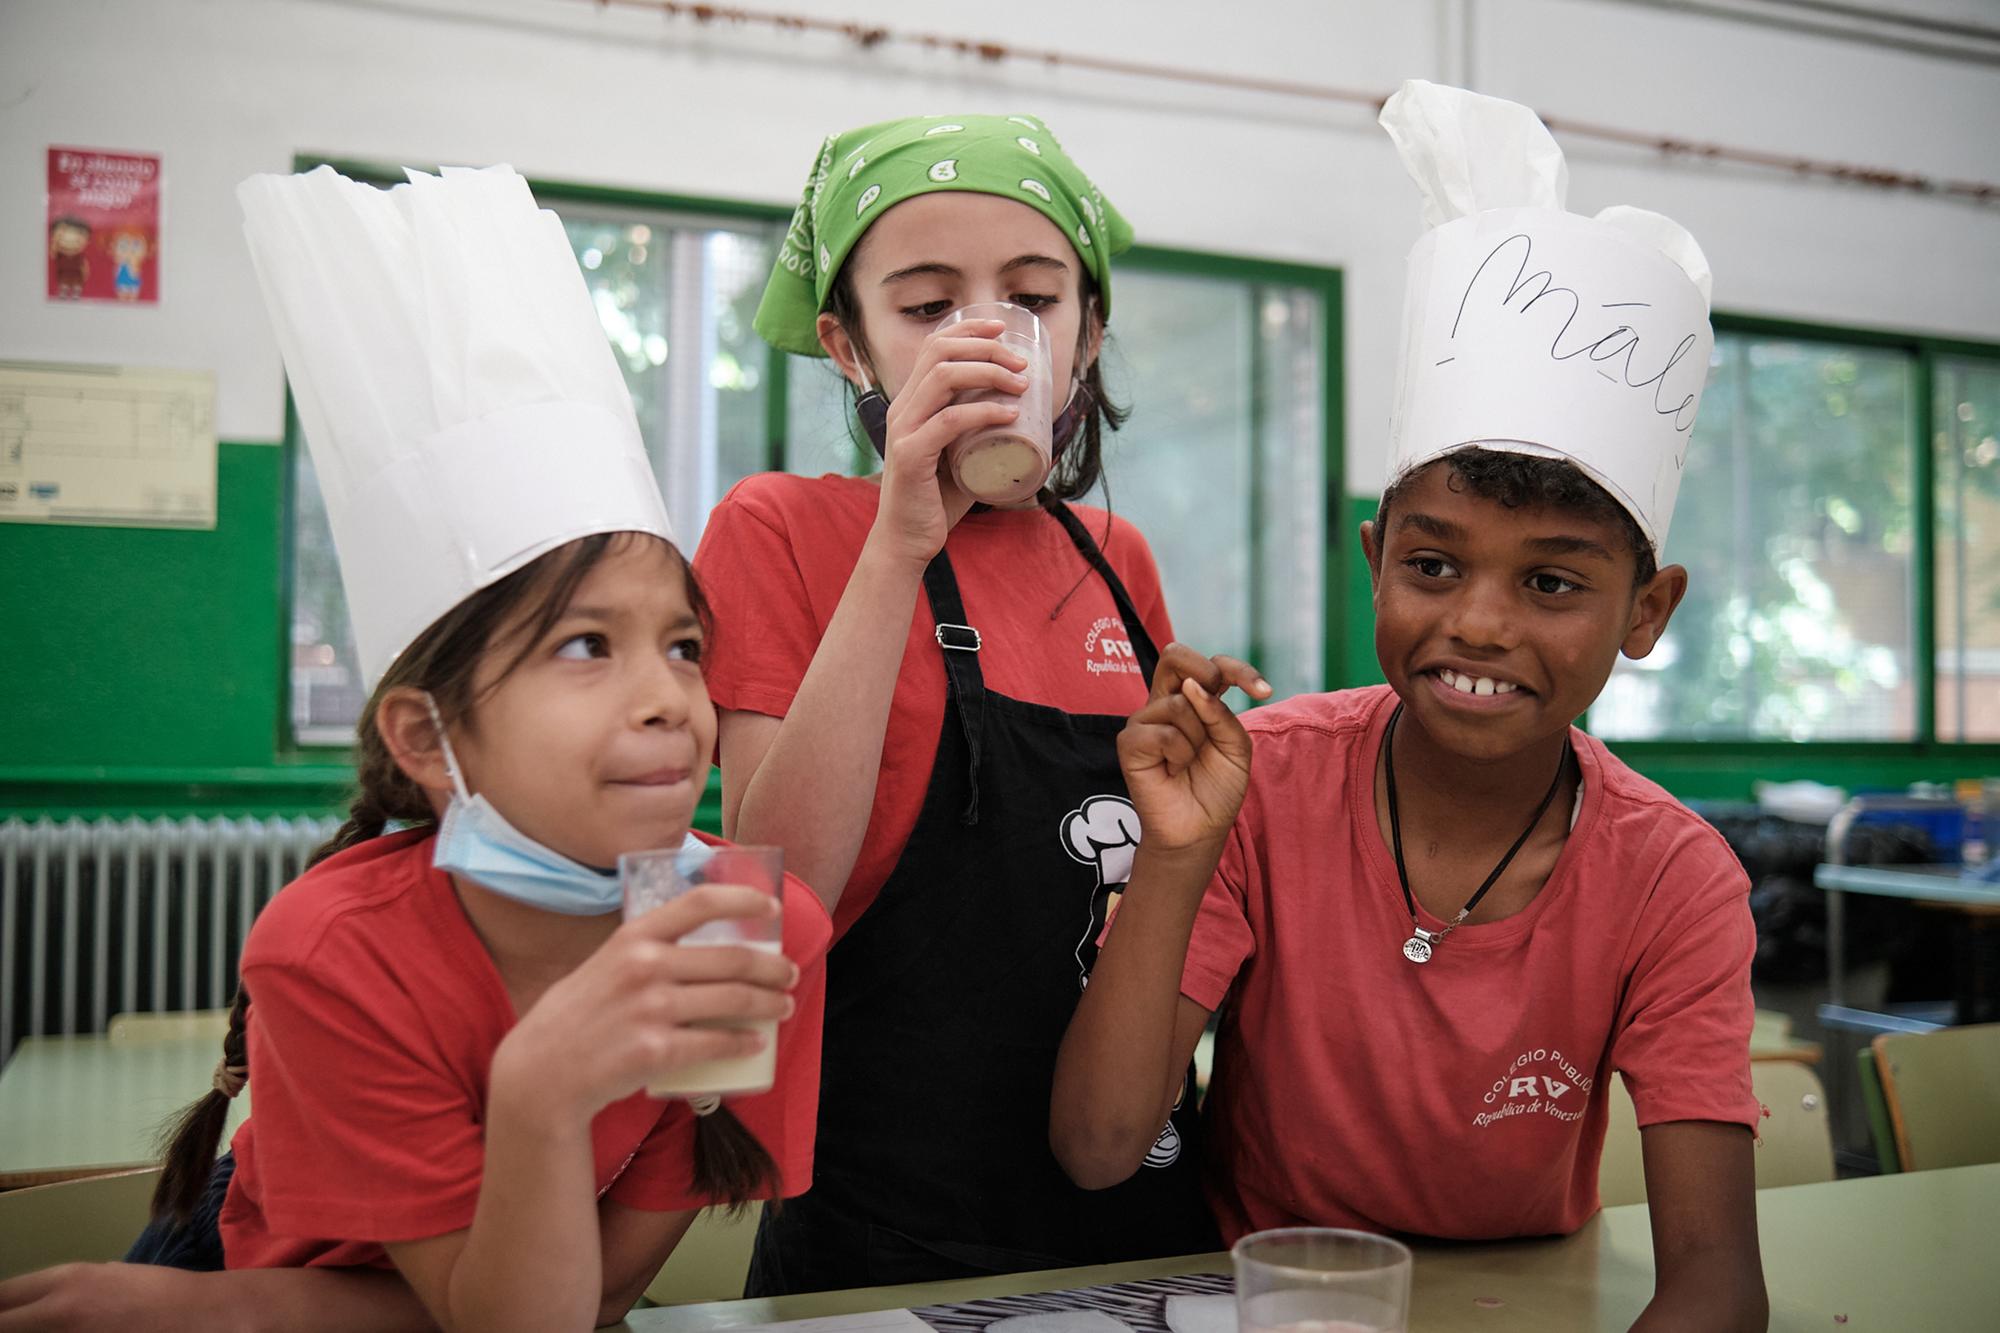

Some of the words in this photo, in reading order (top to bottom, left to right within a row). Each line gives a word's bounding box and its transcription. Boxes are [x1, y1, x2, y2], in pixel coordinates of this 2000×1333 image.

[1085, 617, 1111, 653] COLEGIO
[1484, 1049, 1546, 1103] COLEGIO
[1526, 1099, 1542, 1113] de
